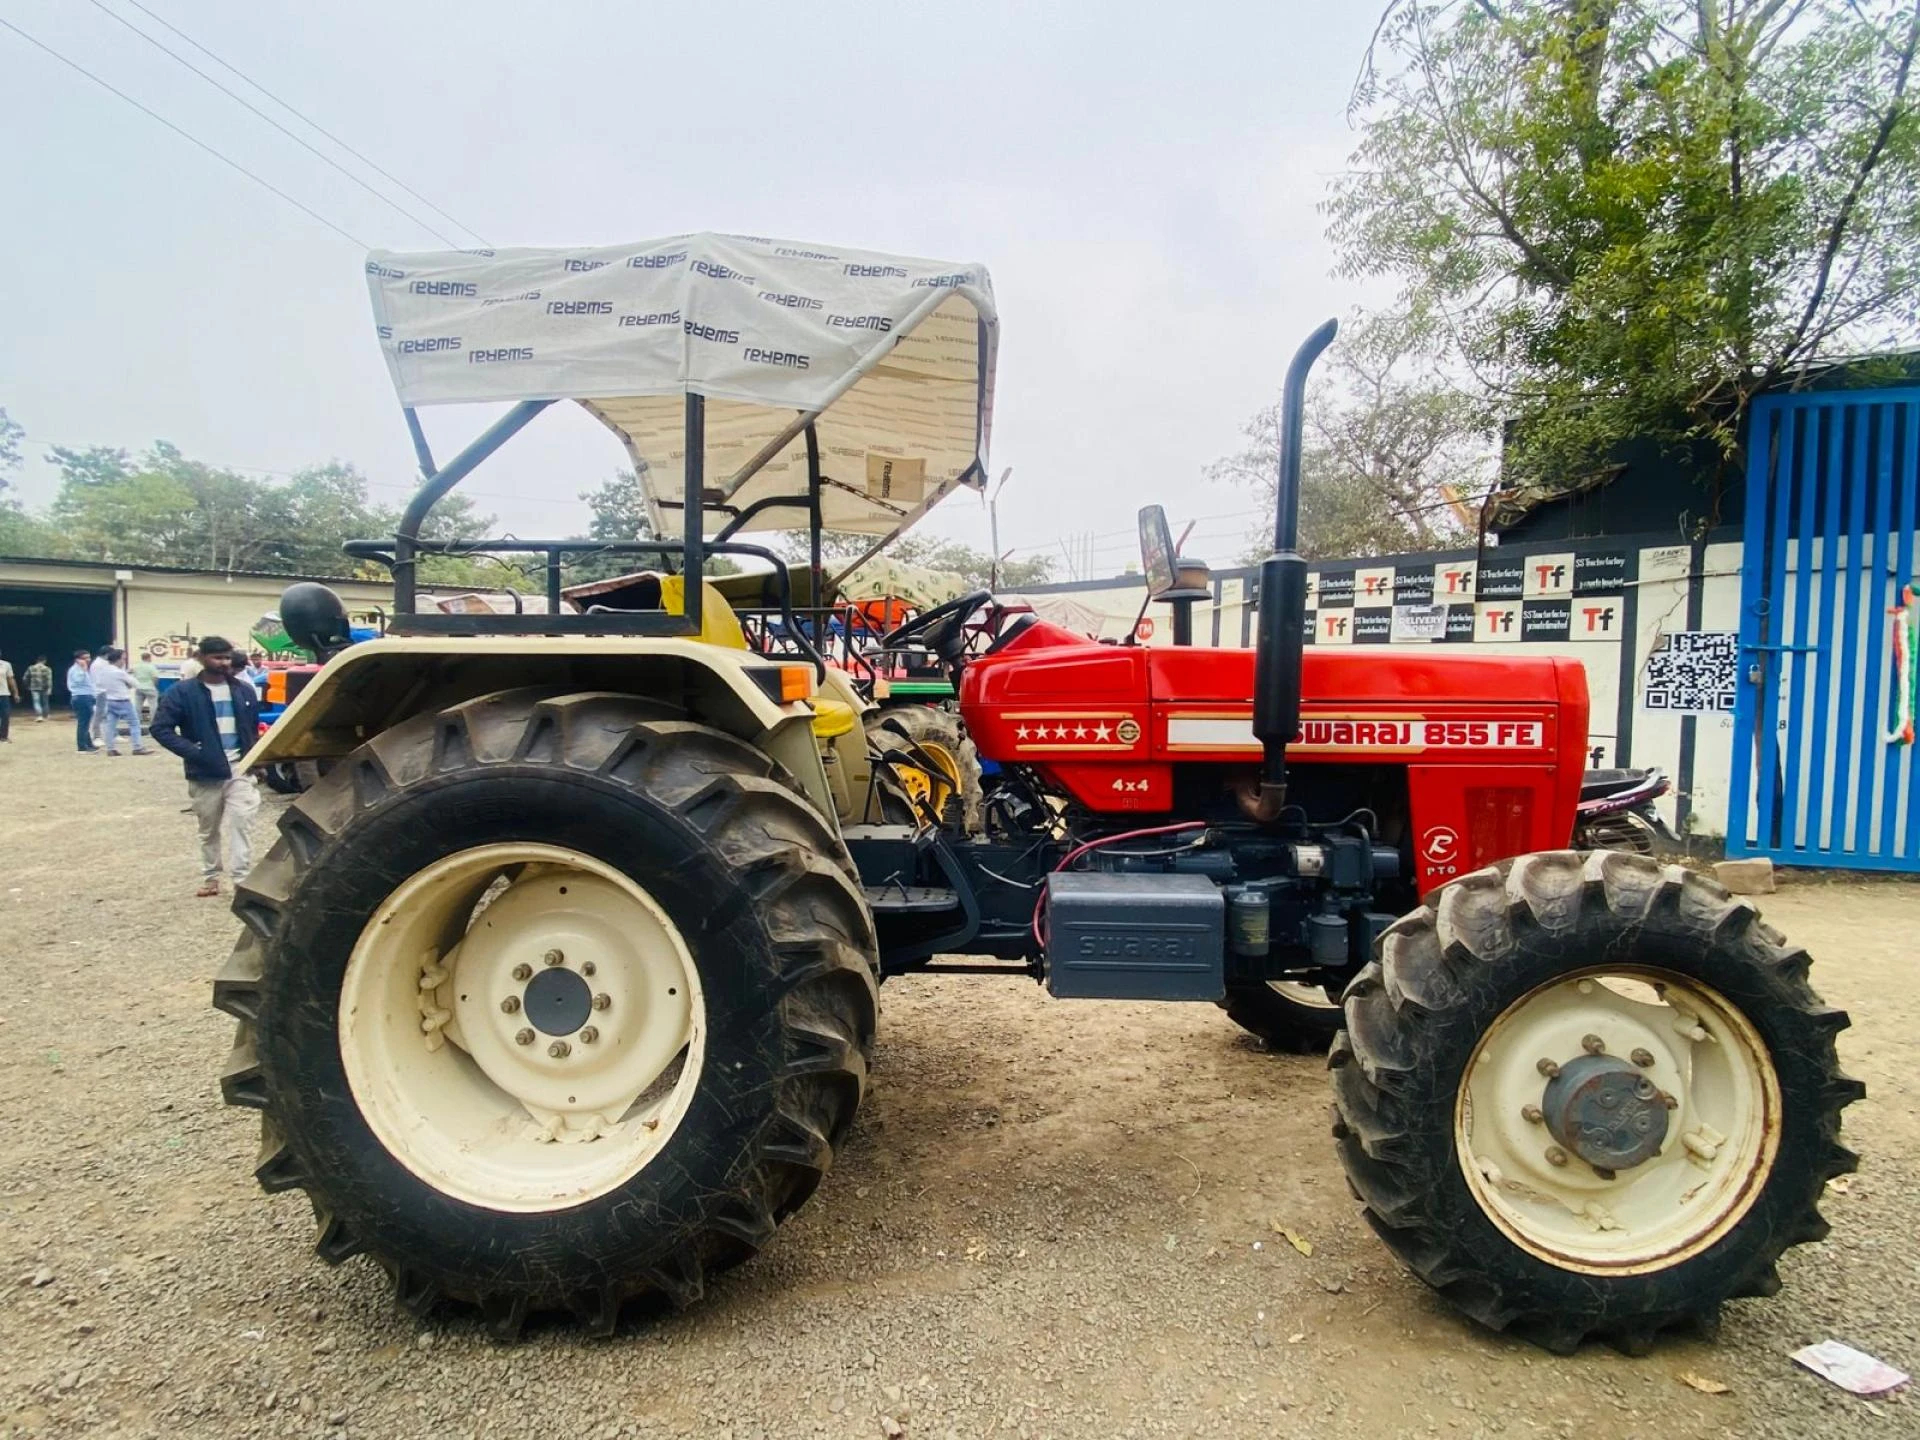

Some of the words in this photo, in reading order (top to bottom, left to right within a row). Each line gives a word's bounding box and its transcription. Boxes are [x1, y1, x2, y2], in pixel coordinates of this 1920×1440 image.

[1423, 723, 1489, 745] 855
[1497, 724, 1535, 745] FE
[1112, 779, 1148, 791] 4x4
[1426, 866, 1457, 876] PTO
